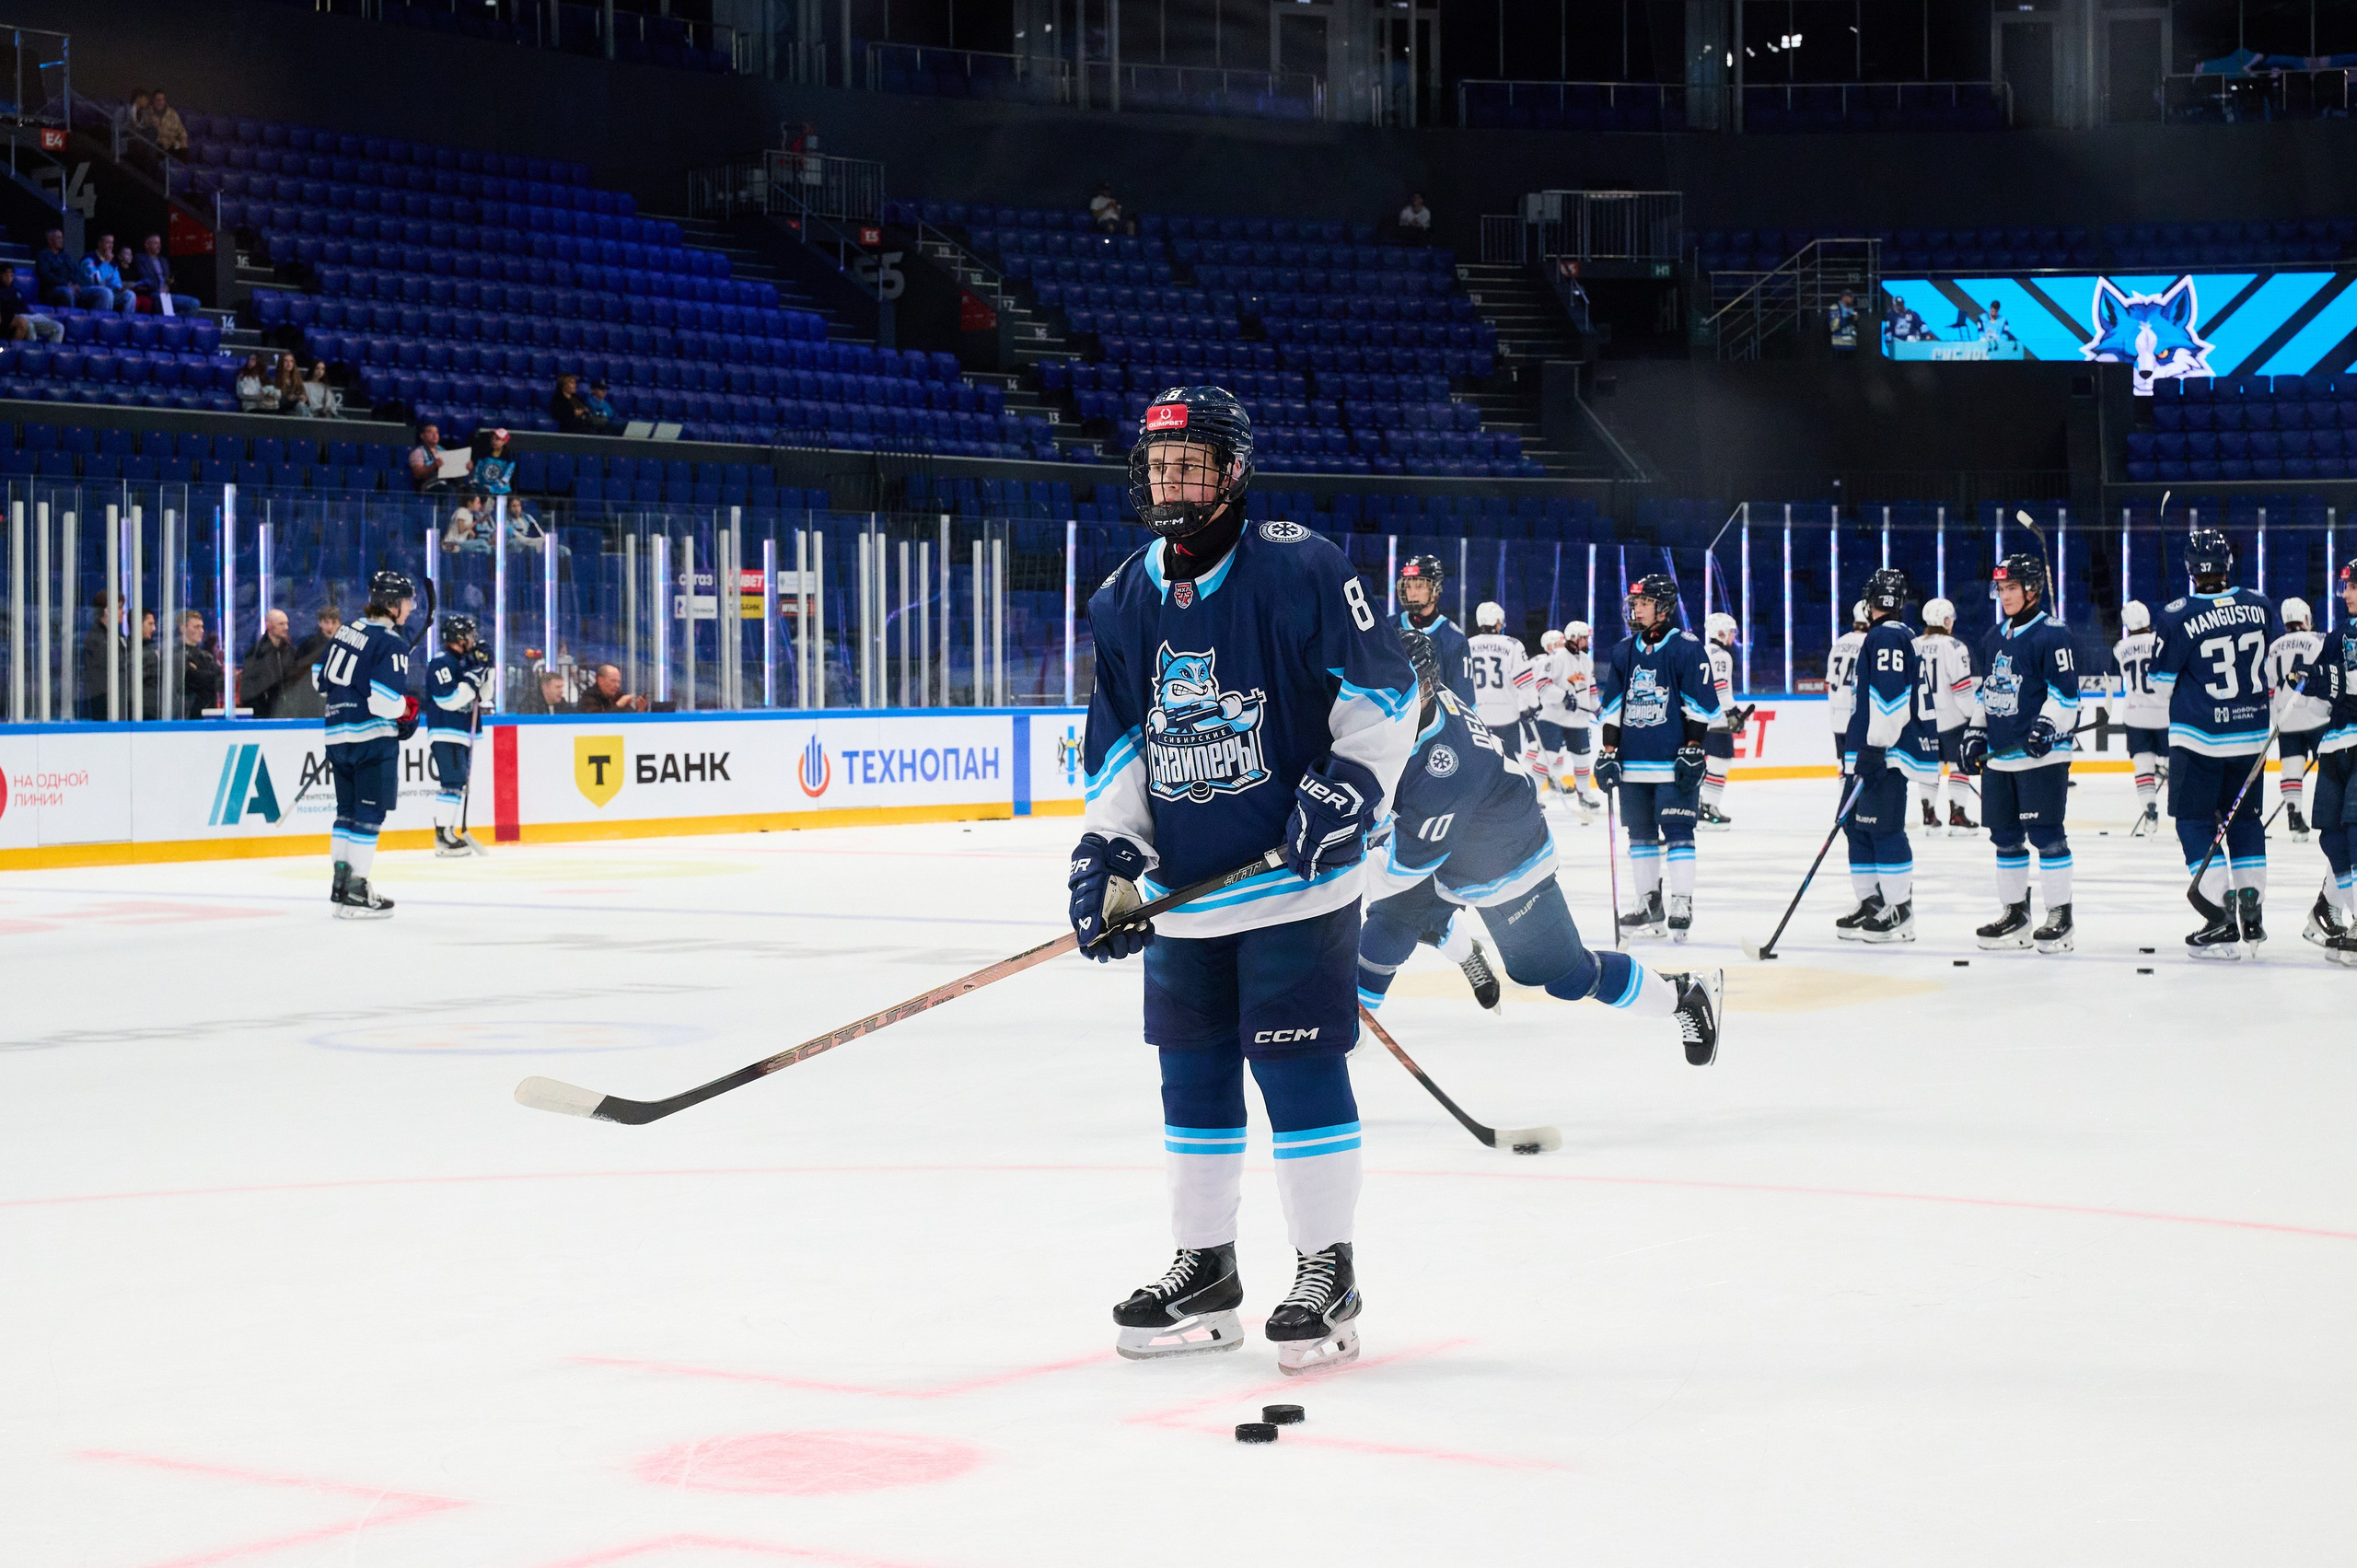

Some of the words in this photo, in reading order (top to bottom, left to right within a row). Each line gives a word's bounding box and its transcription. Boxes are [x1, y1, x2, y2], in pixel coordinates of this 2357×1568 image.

[1149, 420, 1184, 428] OLIMPBET
[2200, 562, 2212, 573] 37
[1343, 575, 1375, 633] 8
[2184, 605, 2266, 640] MANGUSTOV
[1876, 648, 1904, 672] 26
[2200, 629, 2267, 700] 37
[435, 667, 452, 685] 19
[1472, 656, 1504, 690] 63
[1163, 730, 1226, 744] СИБИРСКИЕ
[635, 751, 731, 784] БАНК
[842, 747, 999, 784] ТЕХНОПАН
[13, 774, 33, 788] НА
[36, 770, 88, 789] ОДНОЙ
[14, 793, 63, 807] ЛИНИИ
[1417, 813, 1455, 842] 10
[1254, 1027, 1320, 1044] CCM
